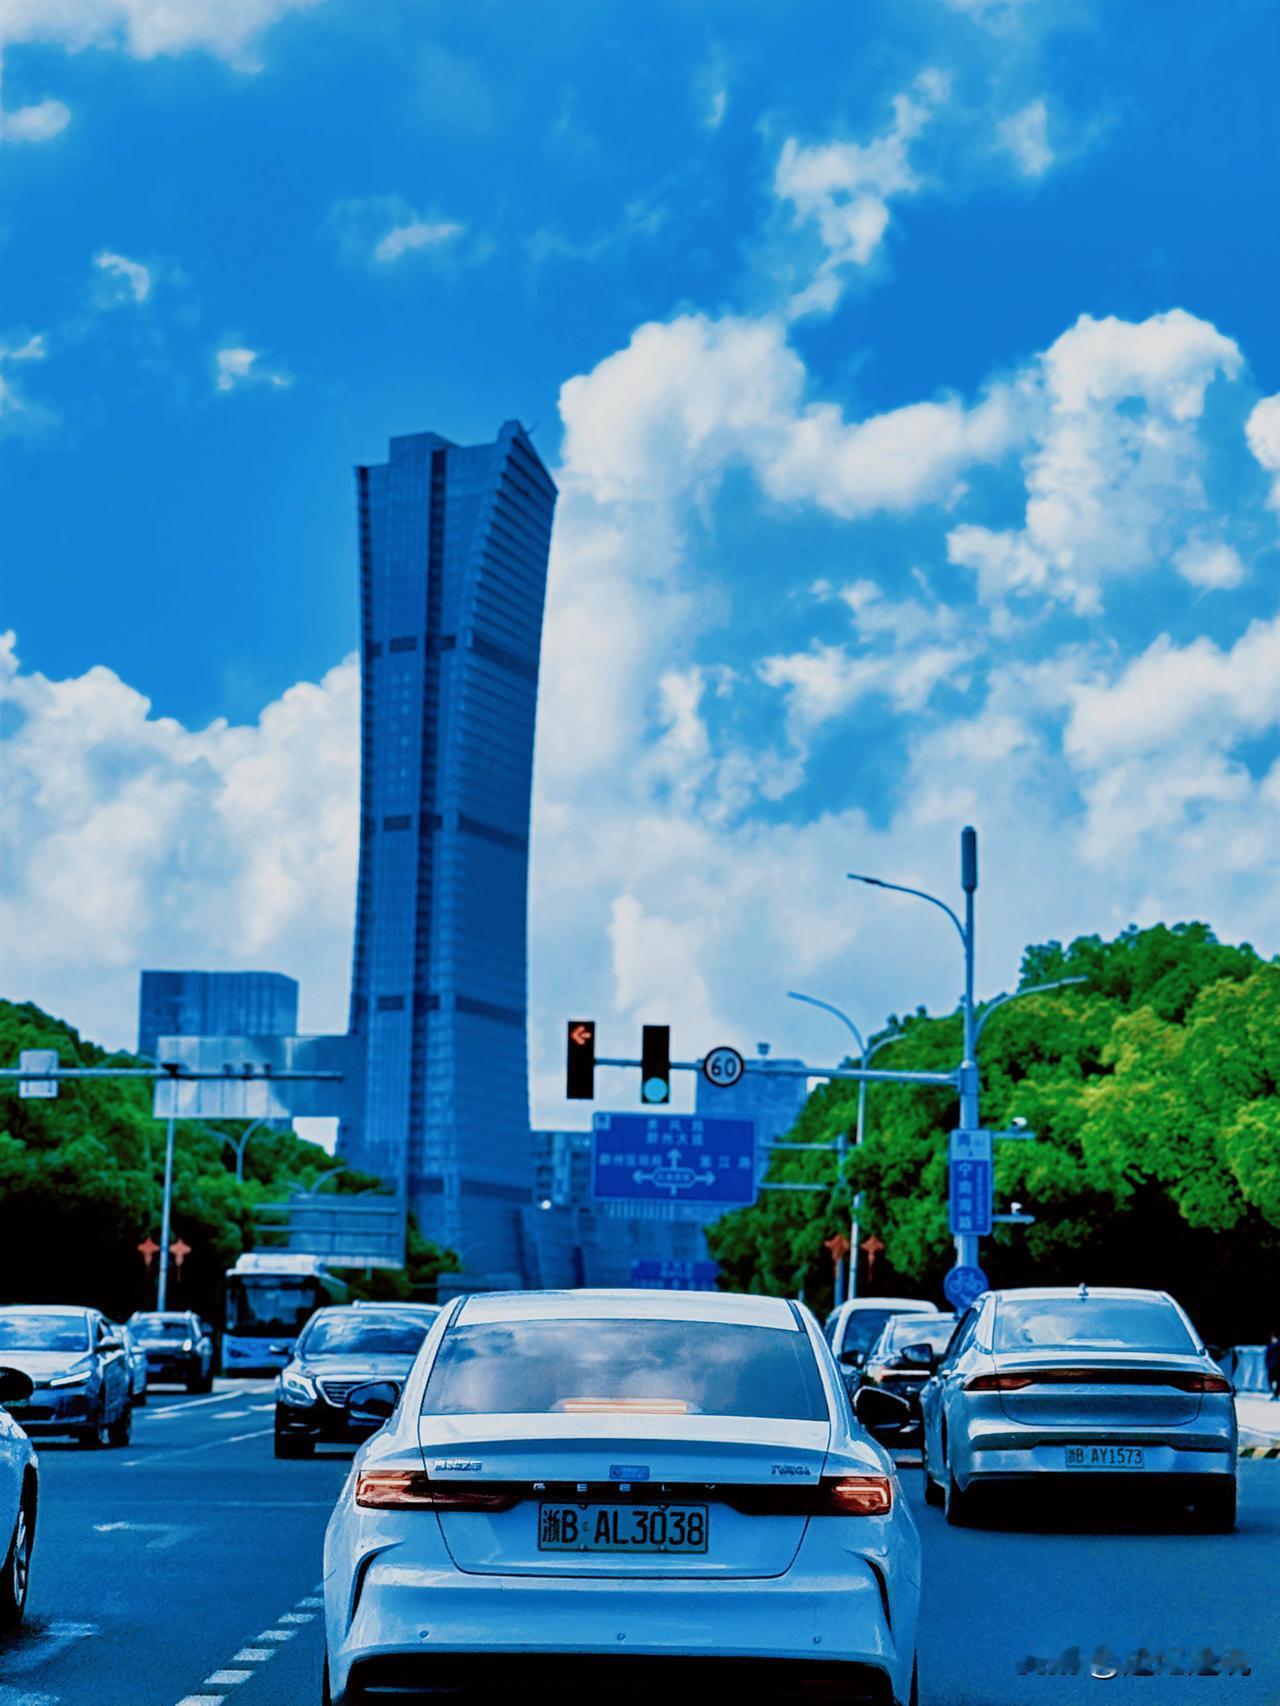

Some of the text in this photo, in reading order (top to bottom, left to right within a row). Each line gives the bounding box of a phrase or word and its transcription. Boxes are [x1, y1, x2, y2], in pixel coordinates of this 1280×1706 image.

[711, 1057, 737, 1078] 60
[1091, 1447, 1143, 1465] AY1573
[533, 1482, 717, 1494] GEELY
[542, 1509, 704, 1545] 浙B AL3038
